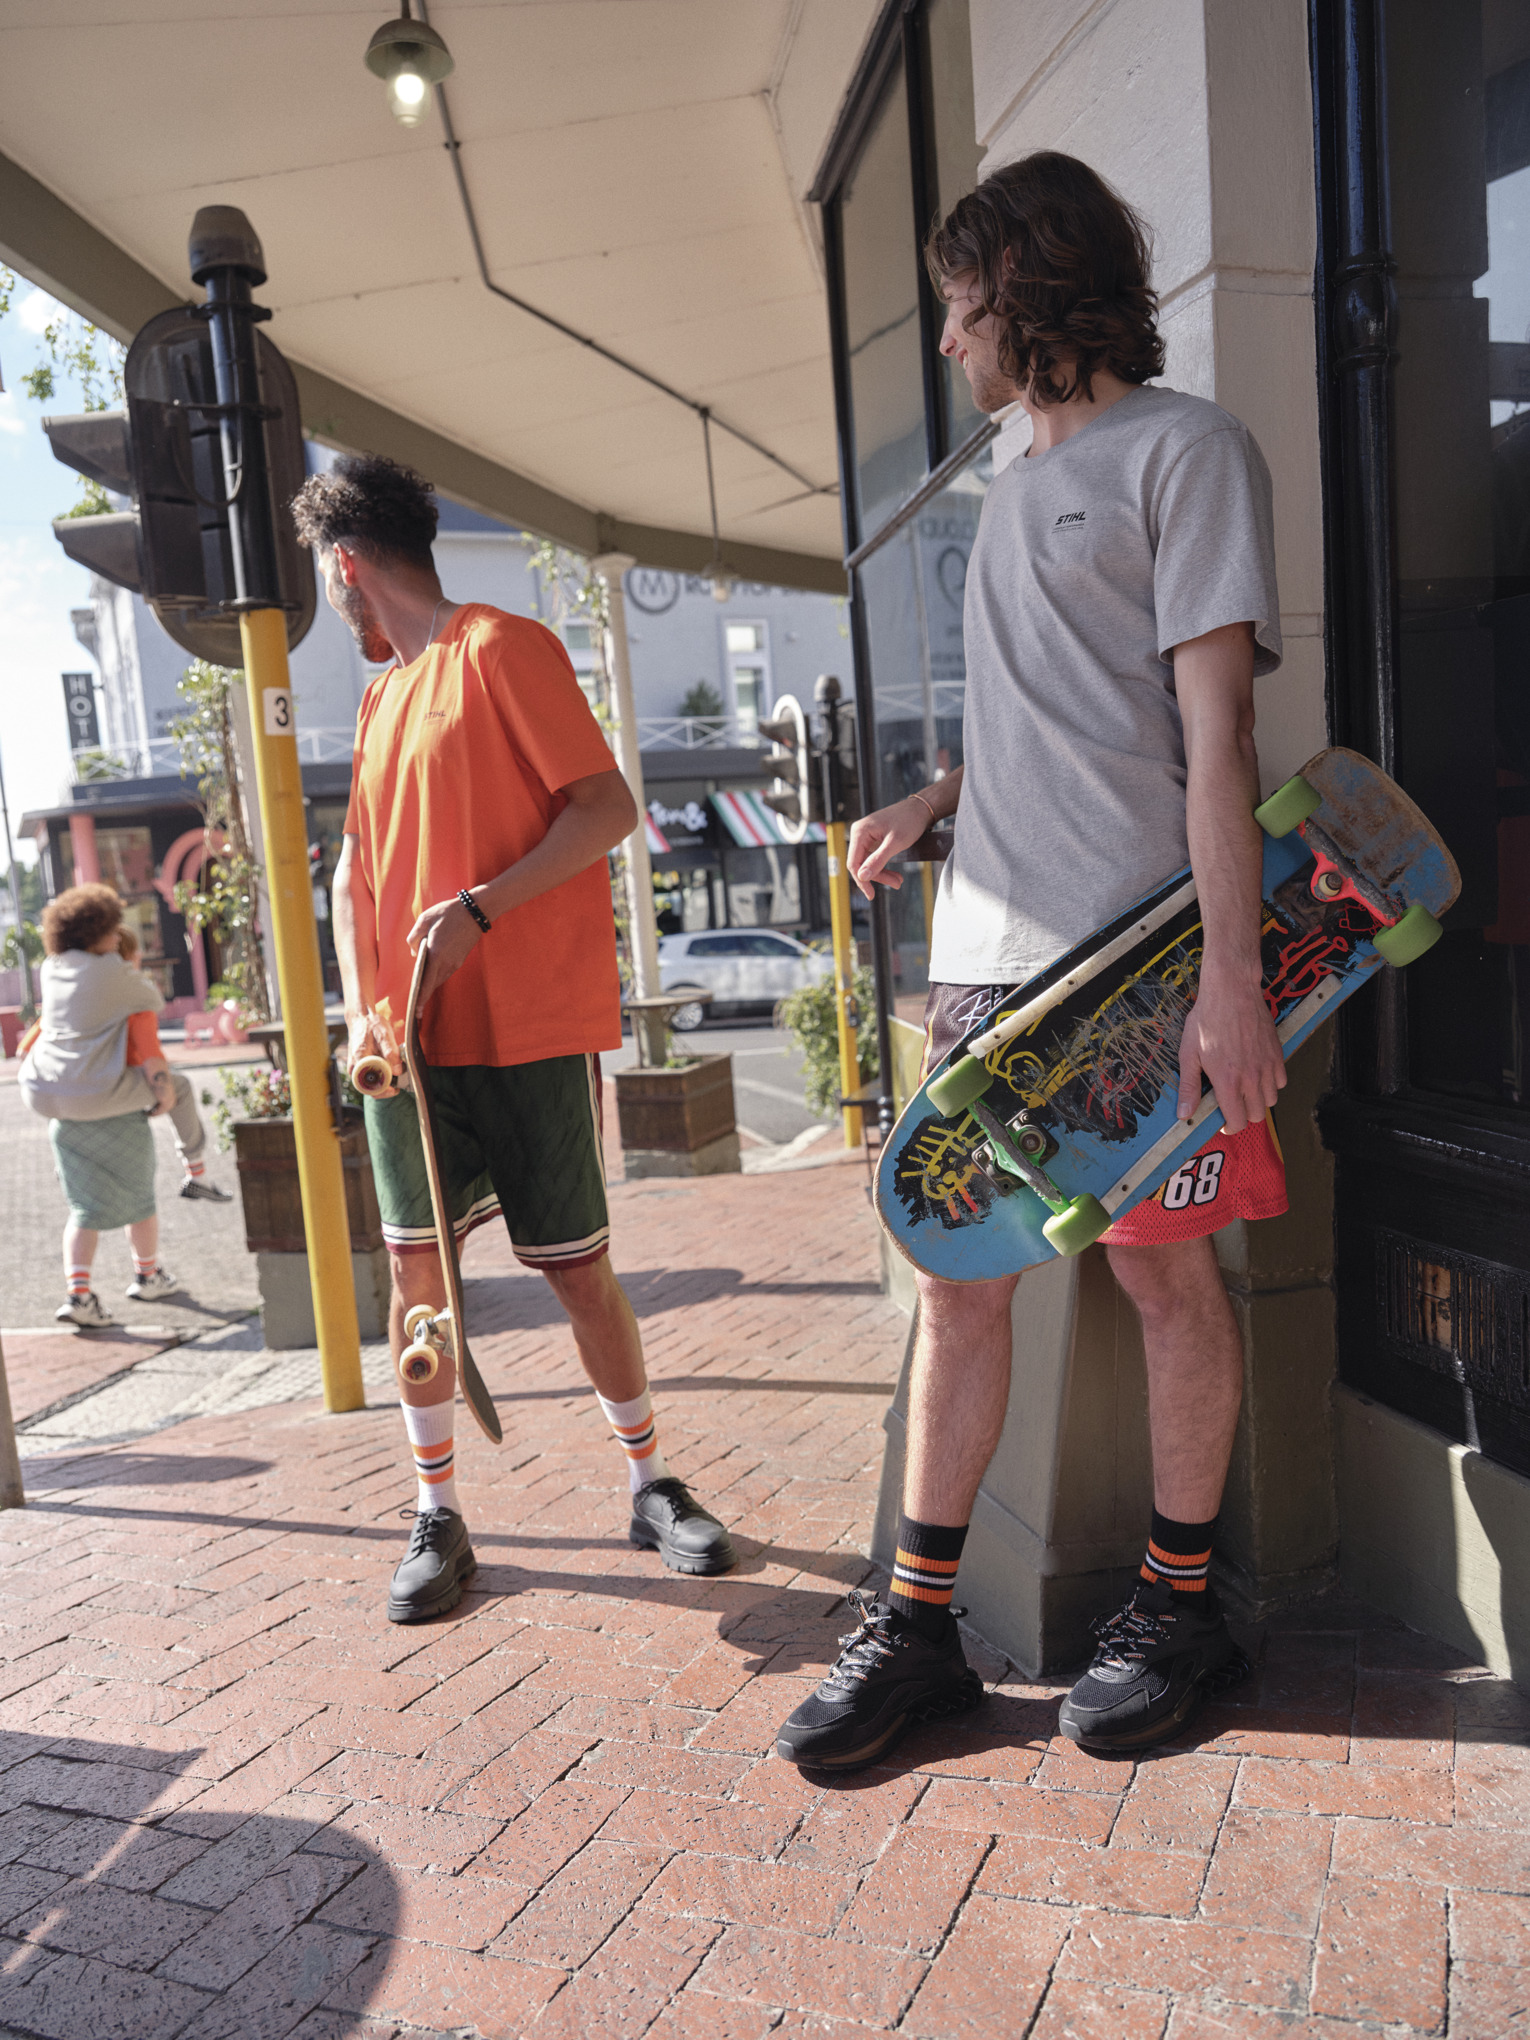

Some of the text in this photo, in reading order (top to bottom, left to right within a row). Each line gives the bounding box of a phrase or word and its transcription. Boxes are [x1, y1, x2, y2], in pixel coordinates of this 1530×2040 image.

[1055, 511, 1086, 526] STIHL
[275, 696, 289, 728] 3
[424, 710, 447, 721] STIHL
[1161, 1149, 1226, 1211] 68
